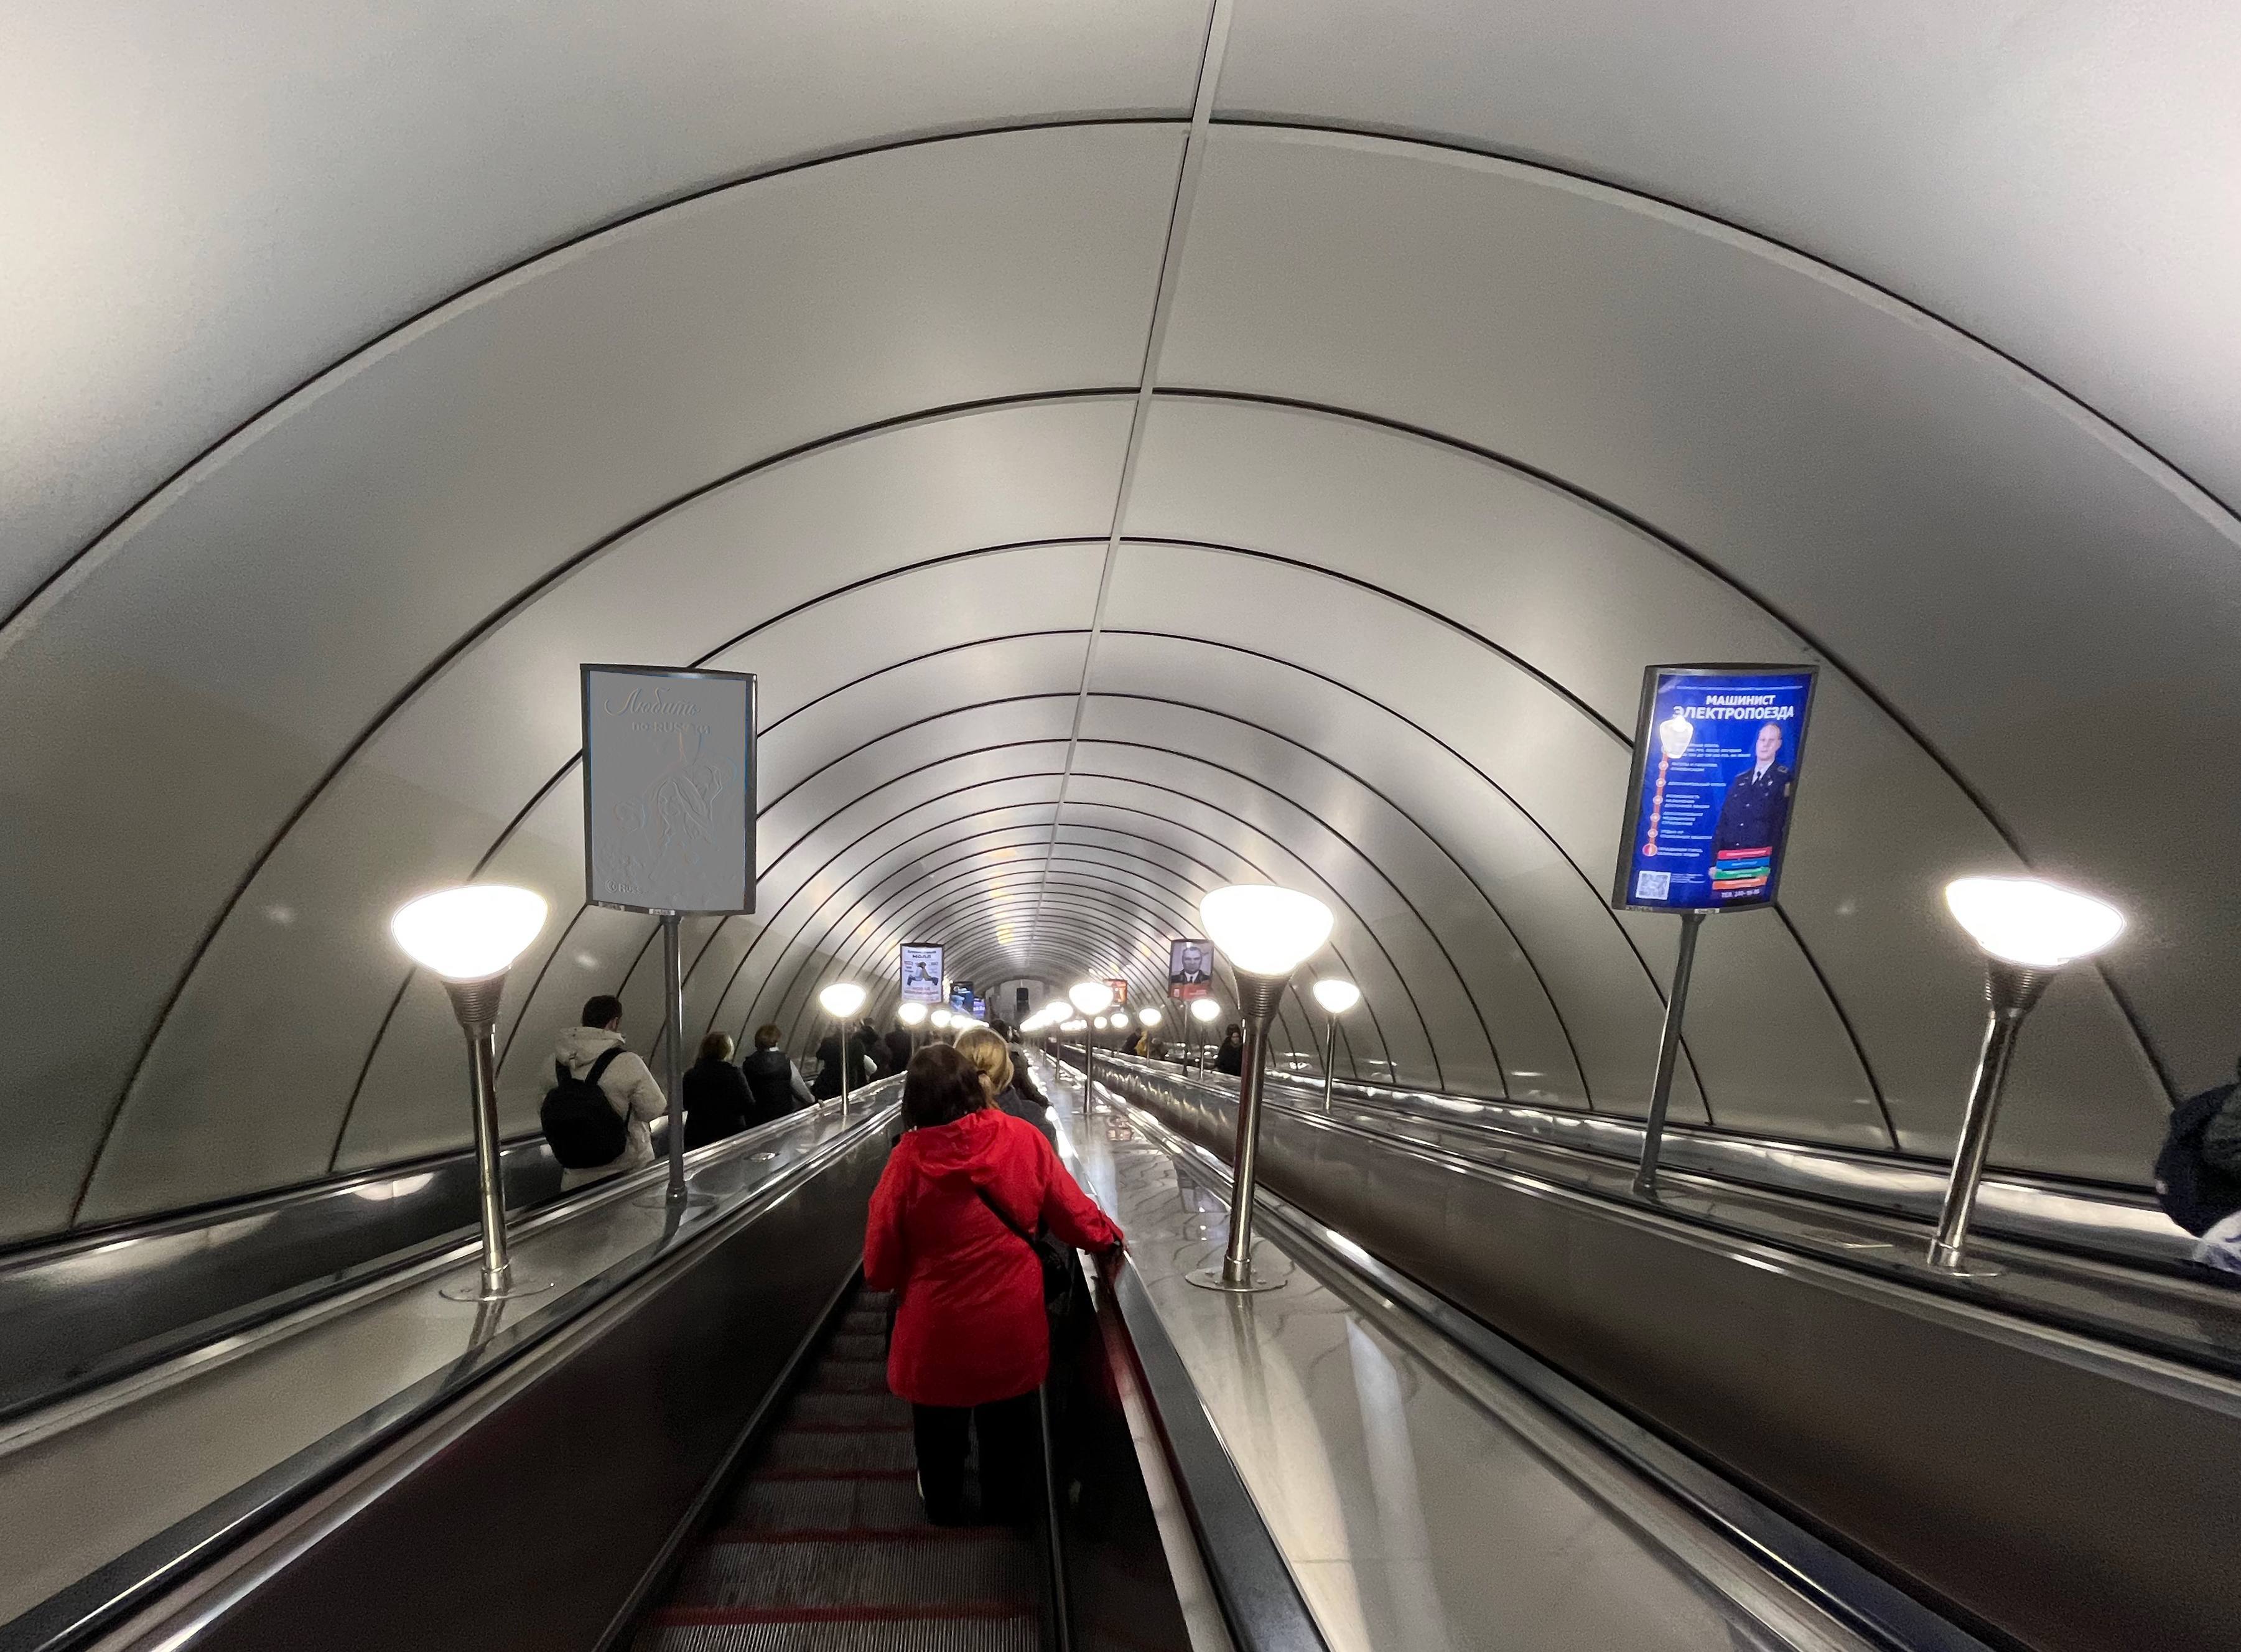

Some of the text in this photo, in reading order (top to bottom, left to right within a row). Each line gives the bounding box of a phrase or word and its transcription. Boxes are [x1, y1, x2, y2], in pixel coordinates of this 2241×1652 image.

[604, 687, 701, 716] Любить
[1706, 695, 1776, 706] МАШИНИСТ
[1672, 706, 1794, 720] ЭЛЕКТРОПОЕЗДА
